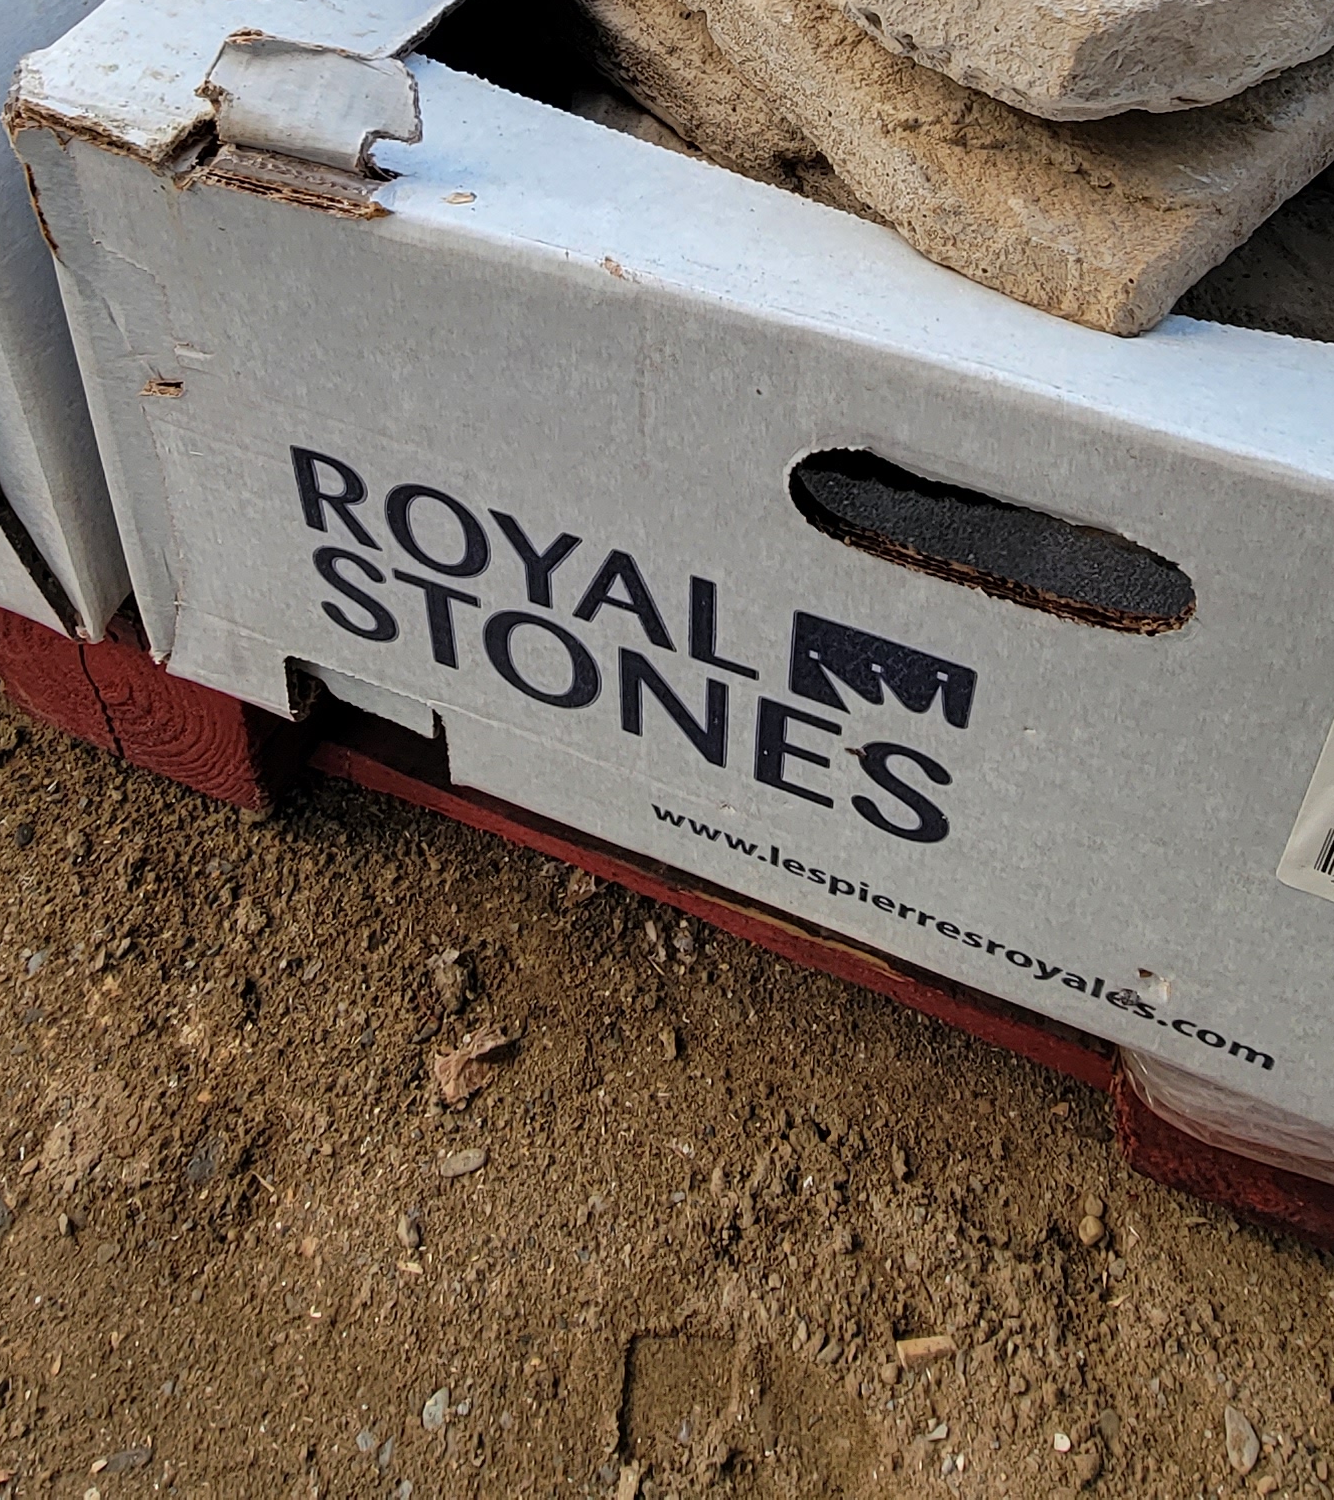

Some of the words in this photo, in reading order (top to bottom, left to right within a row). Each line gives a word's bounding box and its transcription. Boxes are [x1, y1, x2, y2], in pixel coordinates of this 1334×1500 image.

[290, 446, 759, 680] ROYAL
[311, 545, 953, 843] STONES
[650, 802, 1276, 1071] www.lespierresroyales.com
